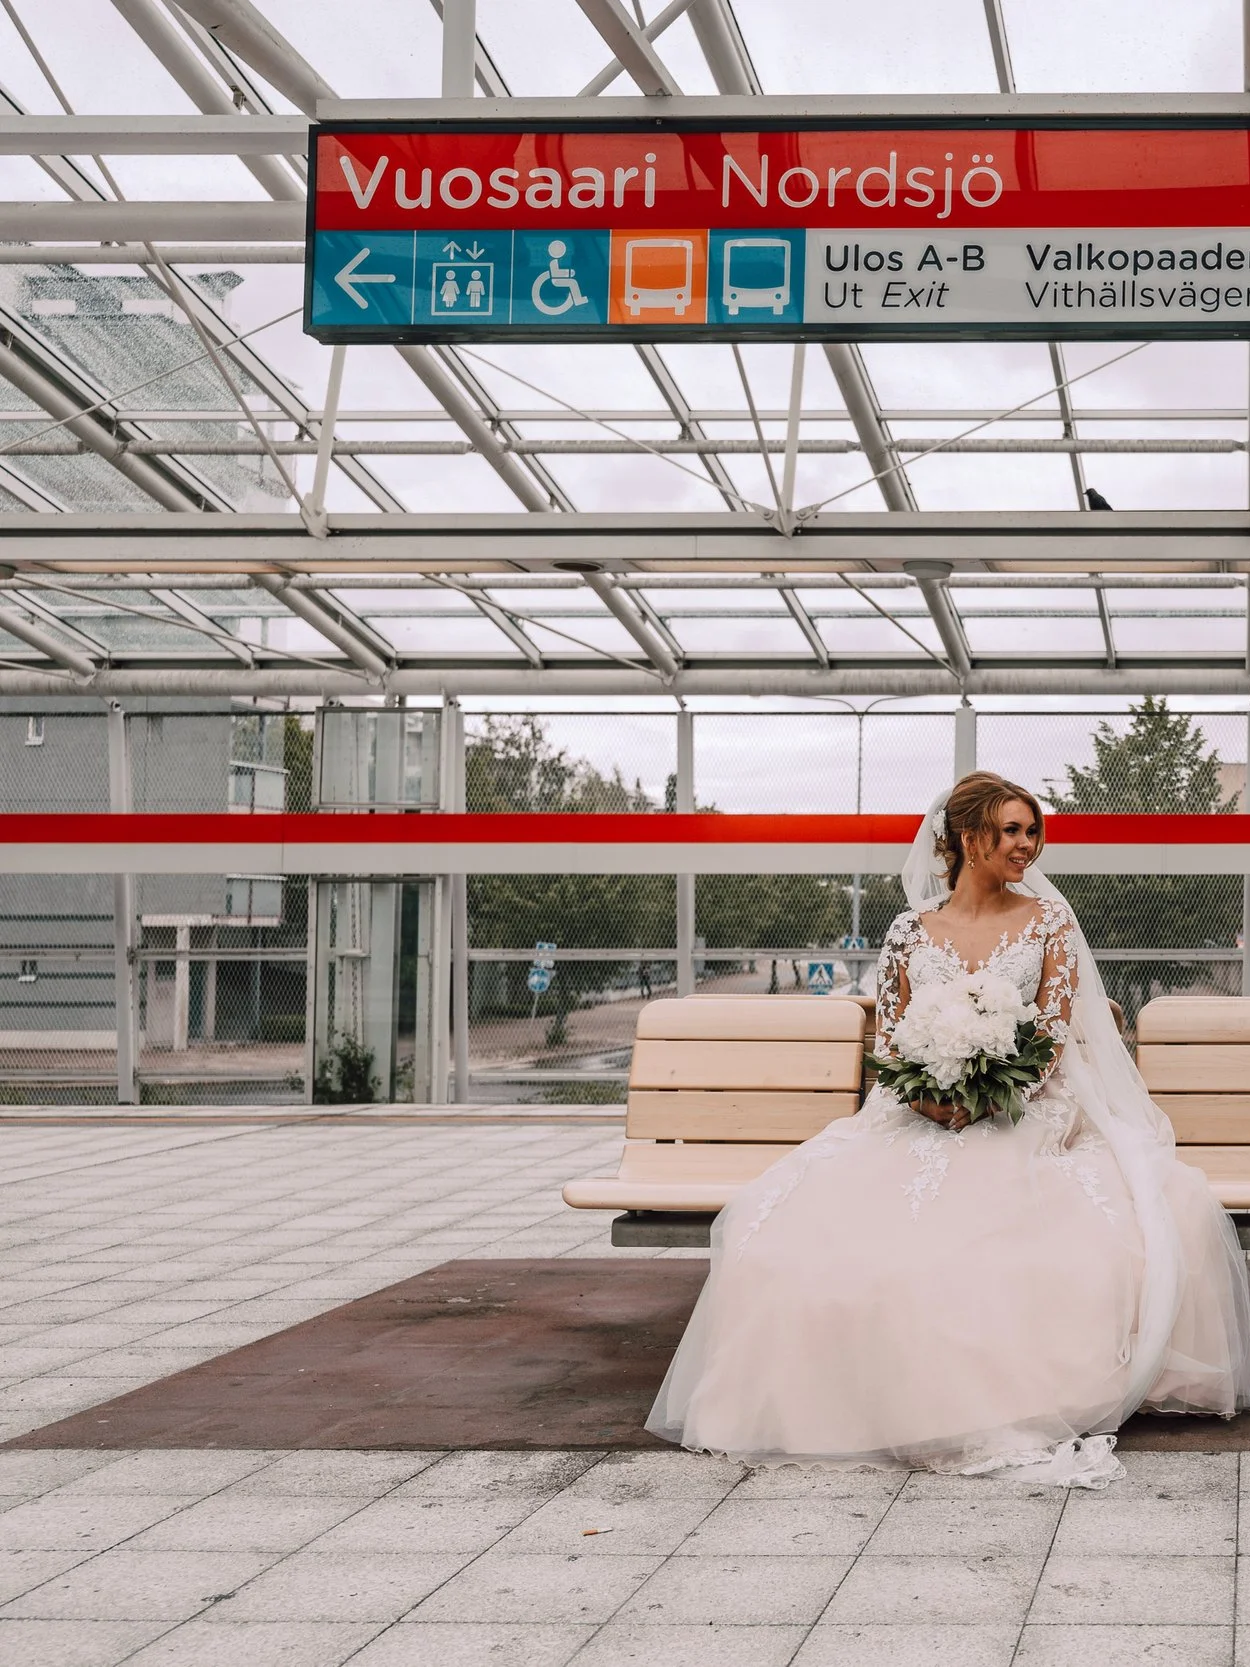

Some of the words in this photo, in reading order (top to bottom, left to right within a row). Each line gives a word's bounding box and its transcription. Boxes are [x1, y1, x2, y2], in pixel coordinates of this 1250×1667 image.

[339, 152, 657, 210] Vuosaari
[722, 150, 1003, 219] Nordsjö
[825, 243, 904, 272] Ulos
[917, 244, 985, 272] A-B
[824, 281, 864, 309] Ut
[881, 280, 950, 308] Exit
